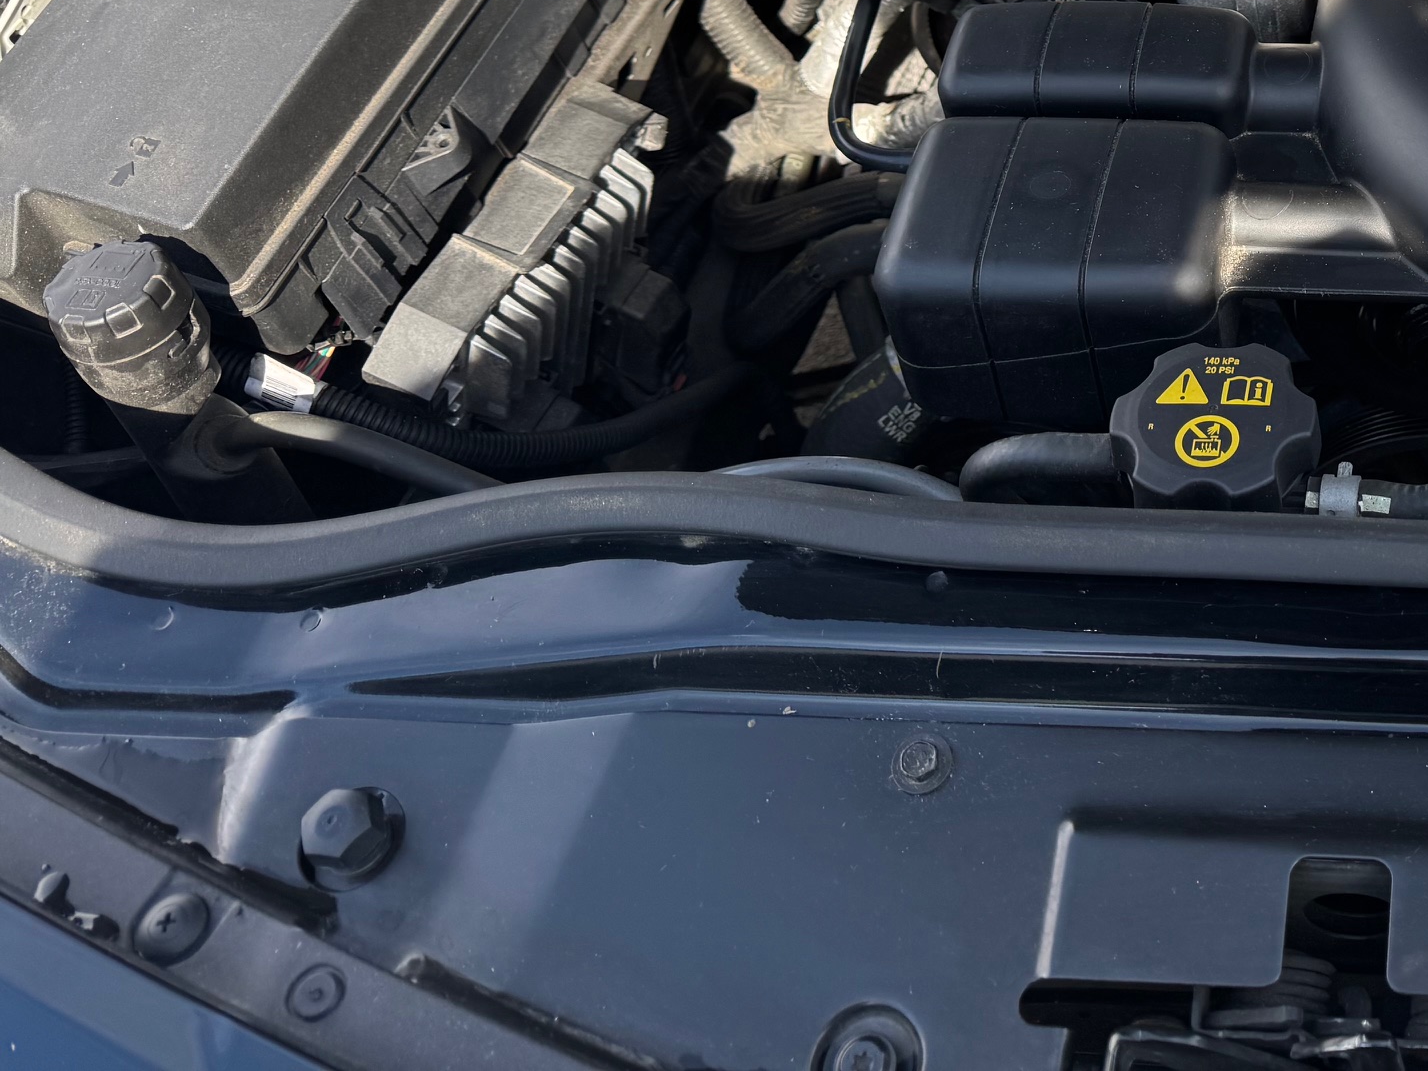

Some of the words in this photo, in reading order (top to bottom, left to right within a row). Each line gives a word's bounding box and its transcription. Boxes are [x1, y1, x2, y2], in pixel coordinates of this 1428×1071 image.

[1203, 356, 1220, 365] 140
[1221, 357, 1241, 366] kPa
[1204, 366, 1217, 374] 20
[1218, 366, 1236, 375] PSI
[877, 414, 908, 443] LWR
[888, 404, 917, 434] ENG
